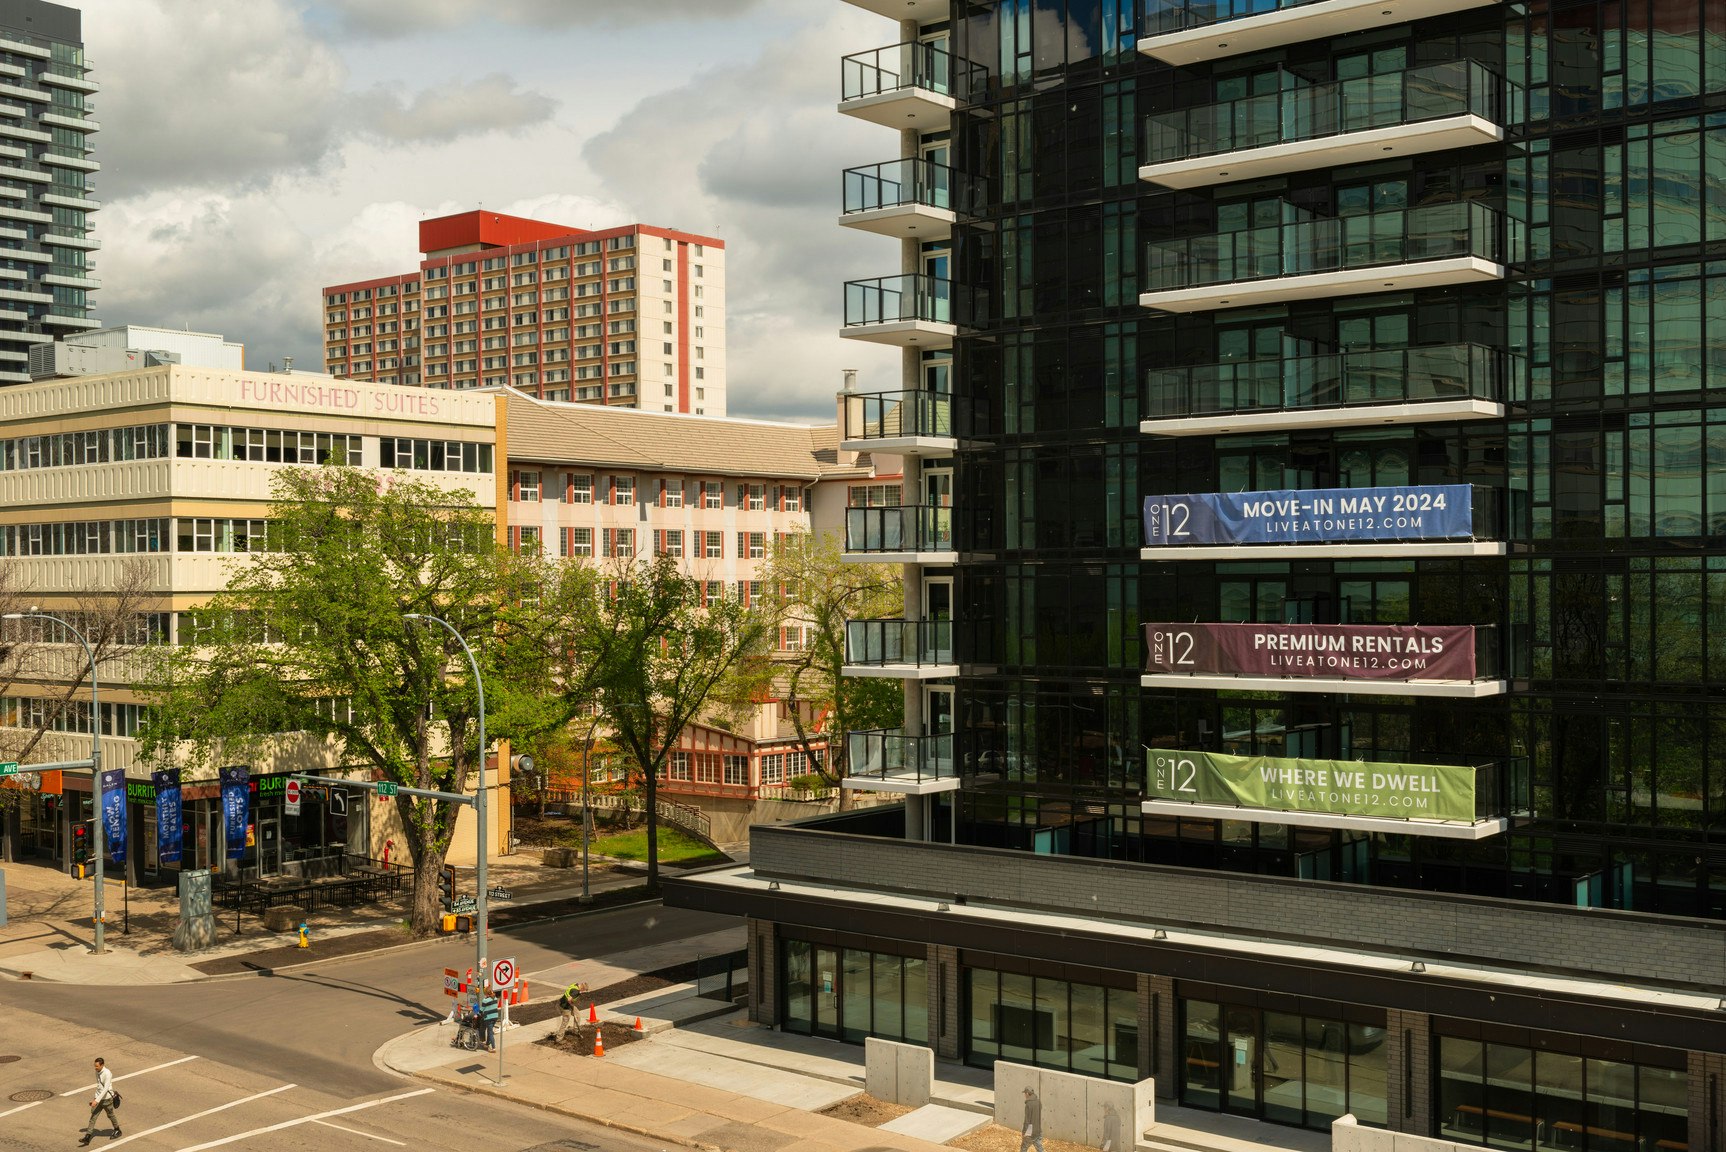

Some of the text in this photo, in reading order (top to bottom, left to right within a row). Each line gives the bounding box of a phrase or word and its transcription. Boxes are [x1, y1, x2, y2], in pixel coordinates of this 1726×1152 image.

[241, 380, 439, 415] FURNISHED SUITES
[1162, 504, 1190, 536] 12
[1243, 493, 1446, 518] MOVE-IN MAY 2024
[1150, 504, 1159, 537] ONE
[1266, 516, 1422, 533] LIVEATONE12.COM
[1154, 632, 1162, 664] ONE
[1166, 632, 1194, 665] 12
[1254, 634, 1443, 654] PREMIUM RENTALS
[1271, 654, 1426, 670] LIVEATONE12.COM
[4, 764, 16, 773] AVE
[1156, 758, 1165, 790] ONE
[1168, 759, 1196, 792] 12
[1260, 766, 1440, 793] WHERE WE DWELL
[378, 783, 397, 794] 112 ST
[1272, 788, 1427, 808] LIVEATONE12.COM
[236, 797, 244, 828] LOFTS
